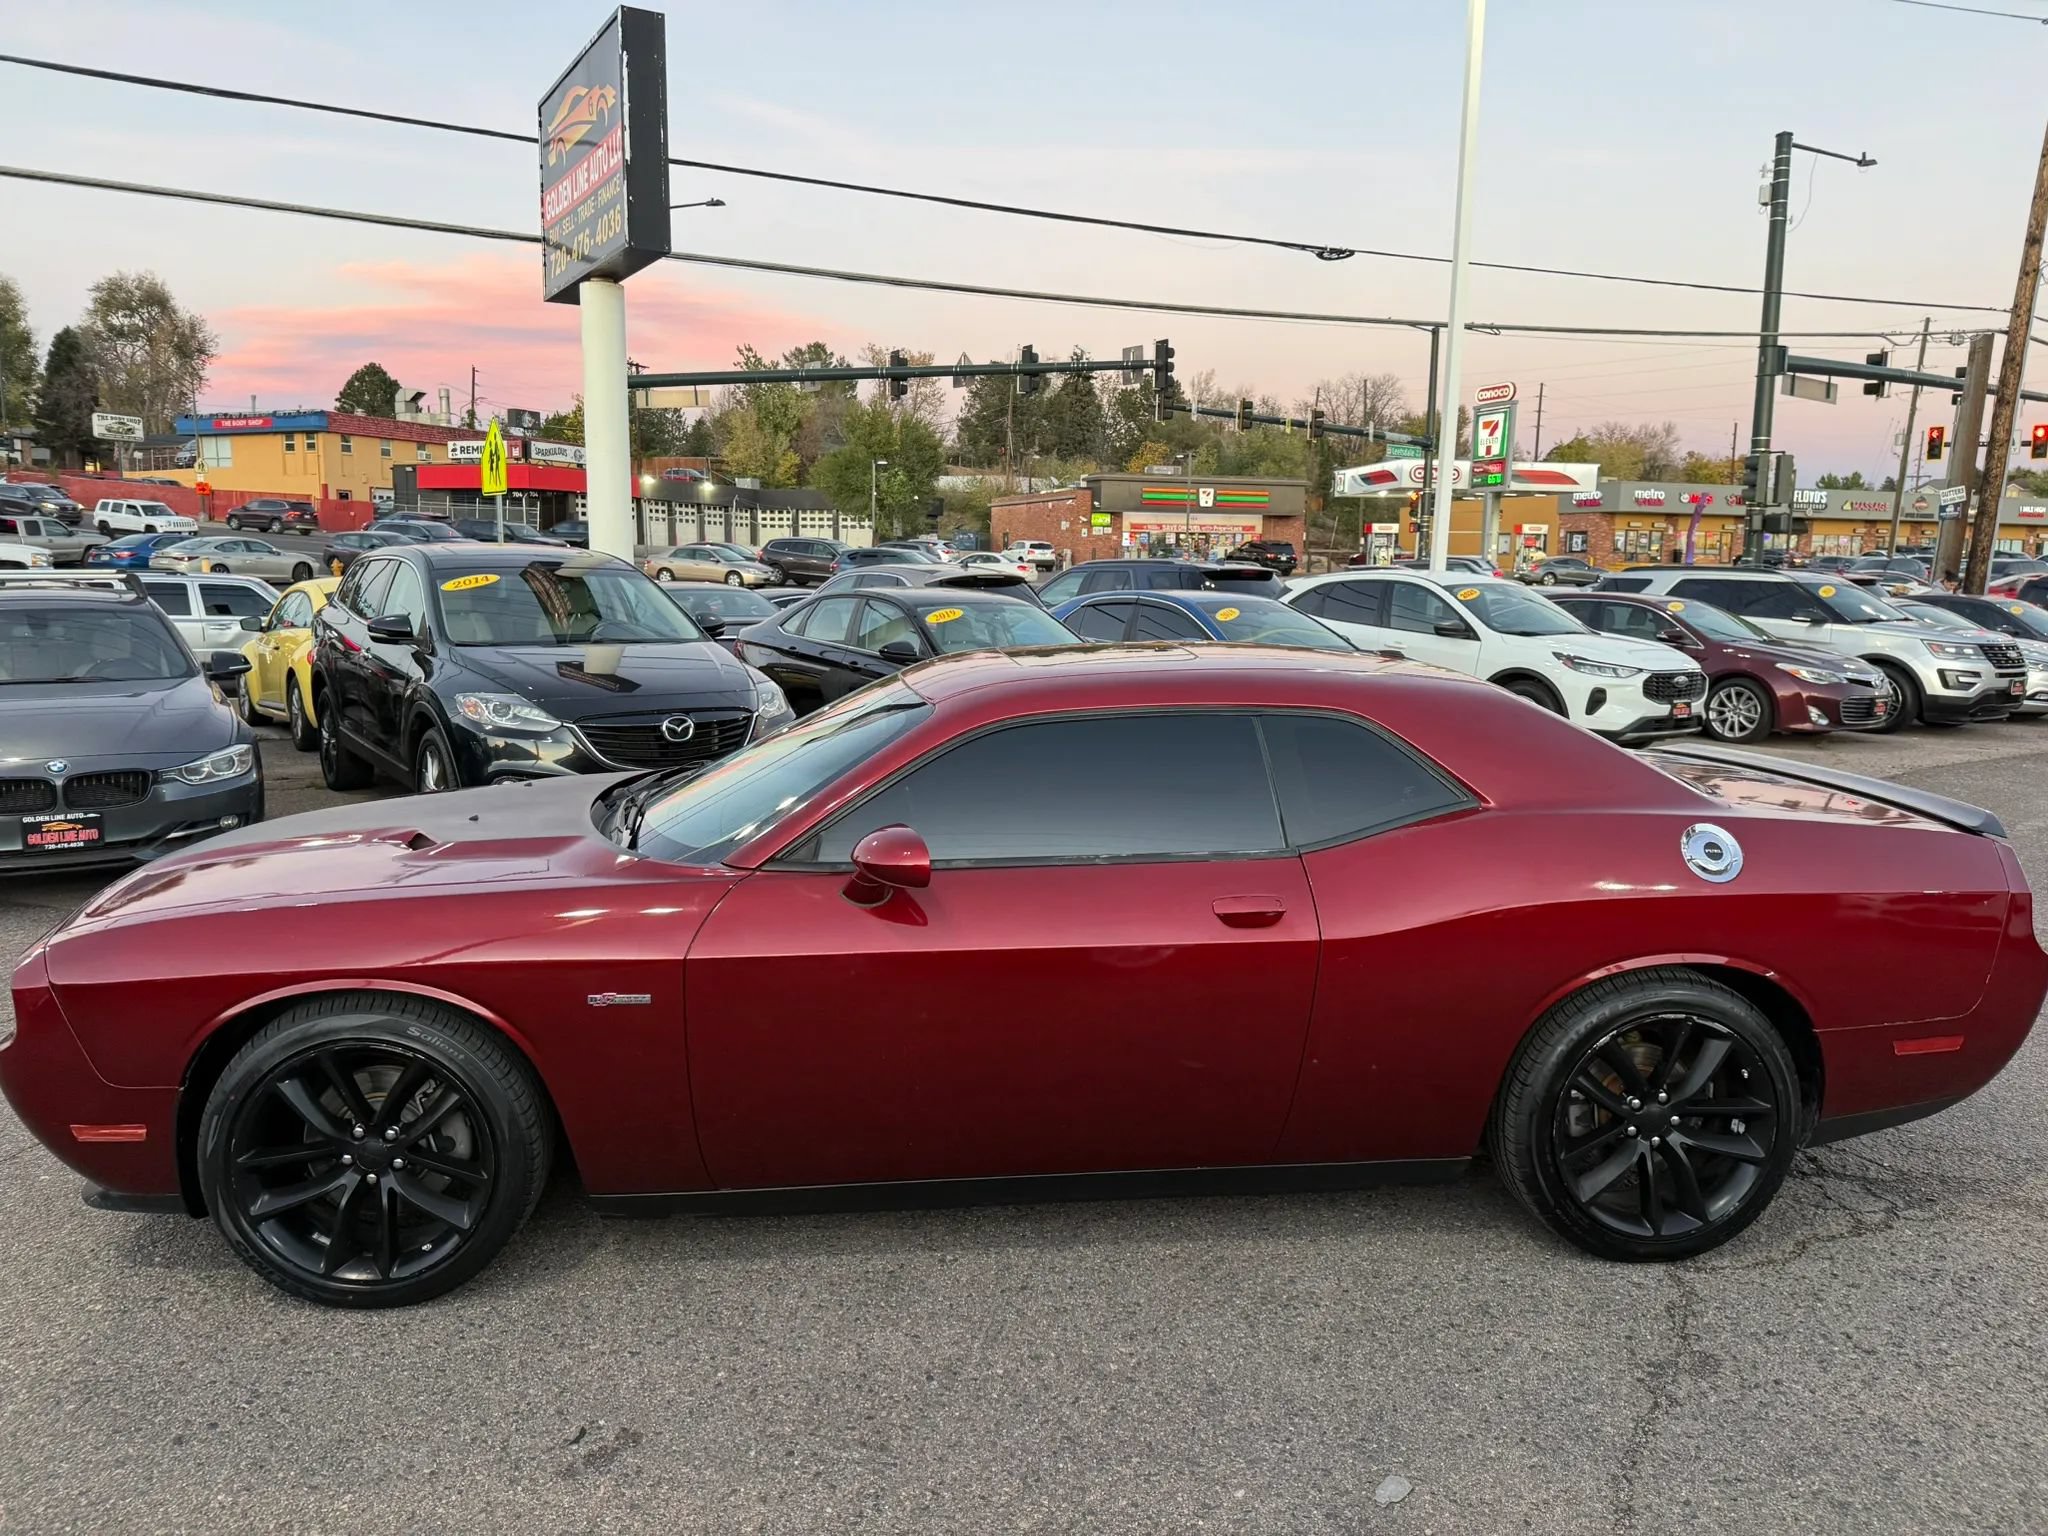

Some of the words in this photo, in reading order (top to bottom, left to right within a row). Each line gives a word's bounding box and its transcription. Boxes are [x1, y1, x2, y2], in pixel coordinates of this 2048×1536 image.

[545, 175, 572, 221] GOLDEN
[572, 160, 589, 200] LINE
[589, 141, 608, 187] AUTO
[562, 214, 575, 236] SELL
[577, 196, 595, 224] TRADE
[597, 173, 621, 208] FINANCE
[1573, 491, 1602, 500] metro
[1634, 488, 1665, 500] metro
[1854, 501, 1889, 511] MASSAGE
[452, 575, 490, 588] 2014
[935, 609, 956, 621] 2019
[22, 815, 50, 823] GOLDEN
[27, 832, 60, 845] GOLDEN
[60, 830, 77, 843] LINE
[78, 828, 99, 841] AUTO
[406, 1026, 465, 1060] Salient
